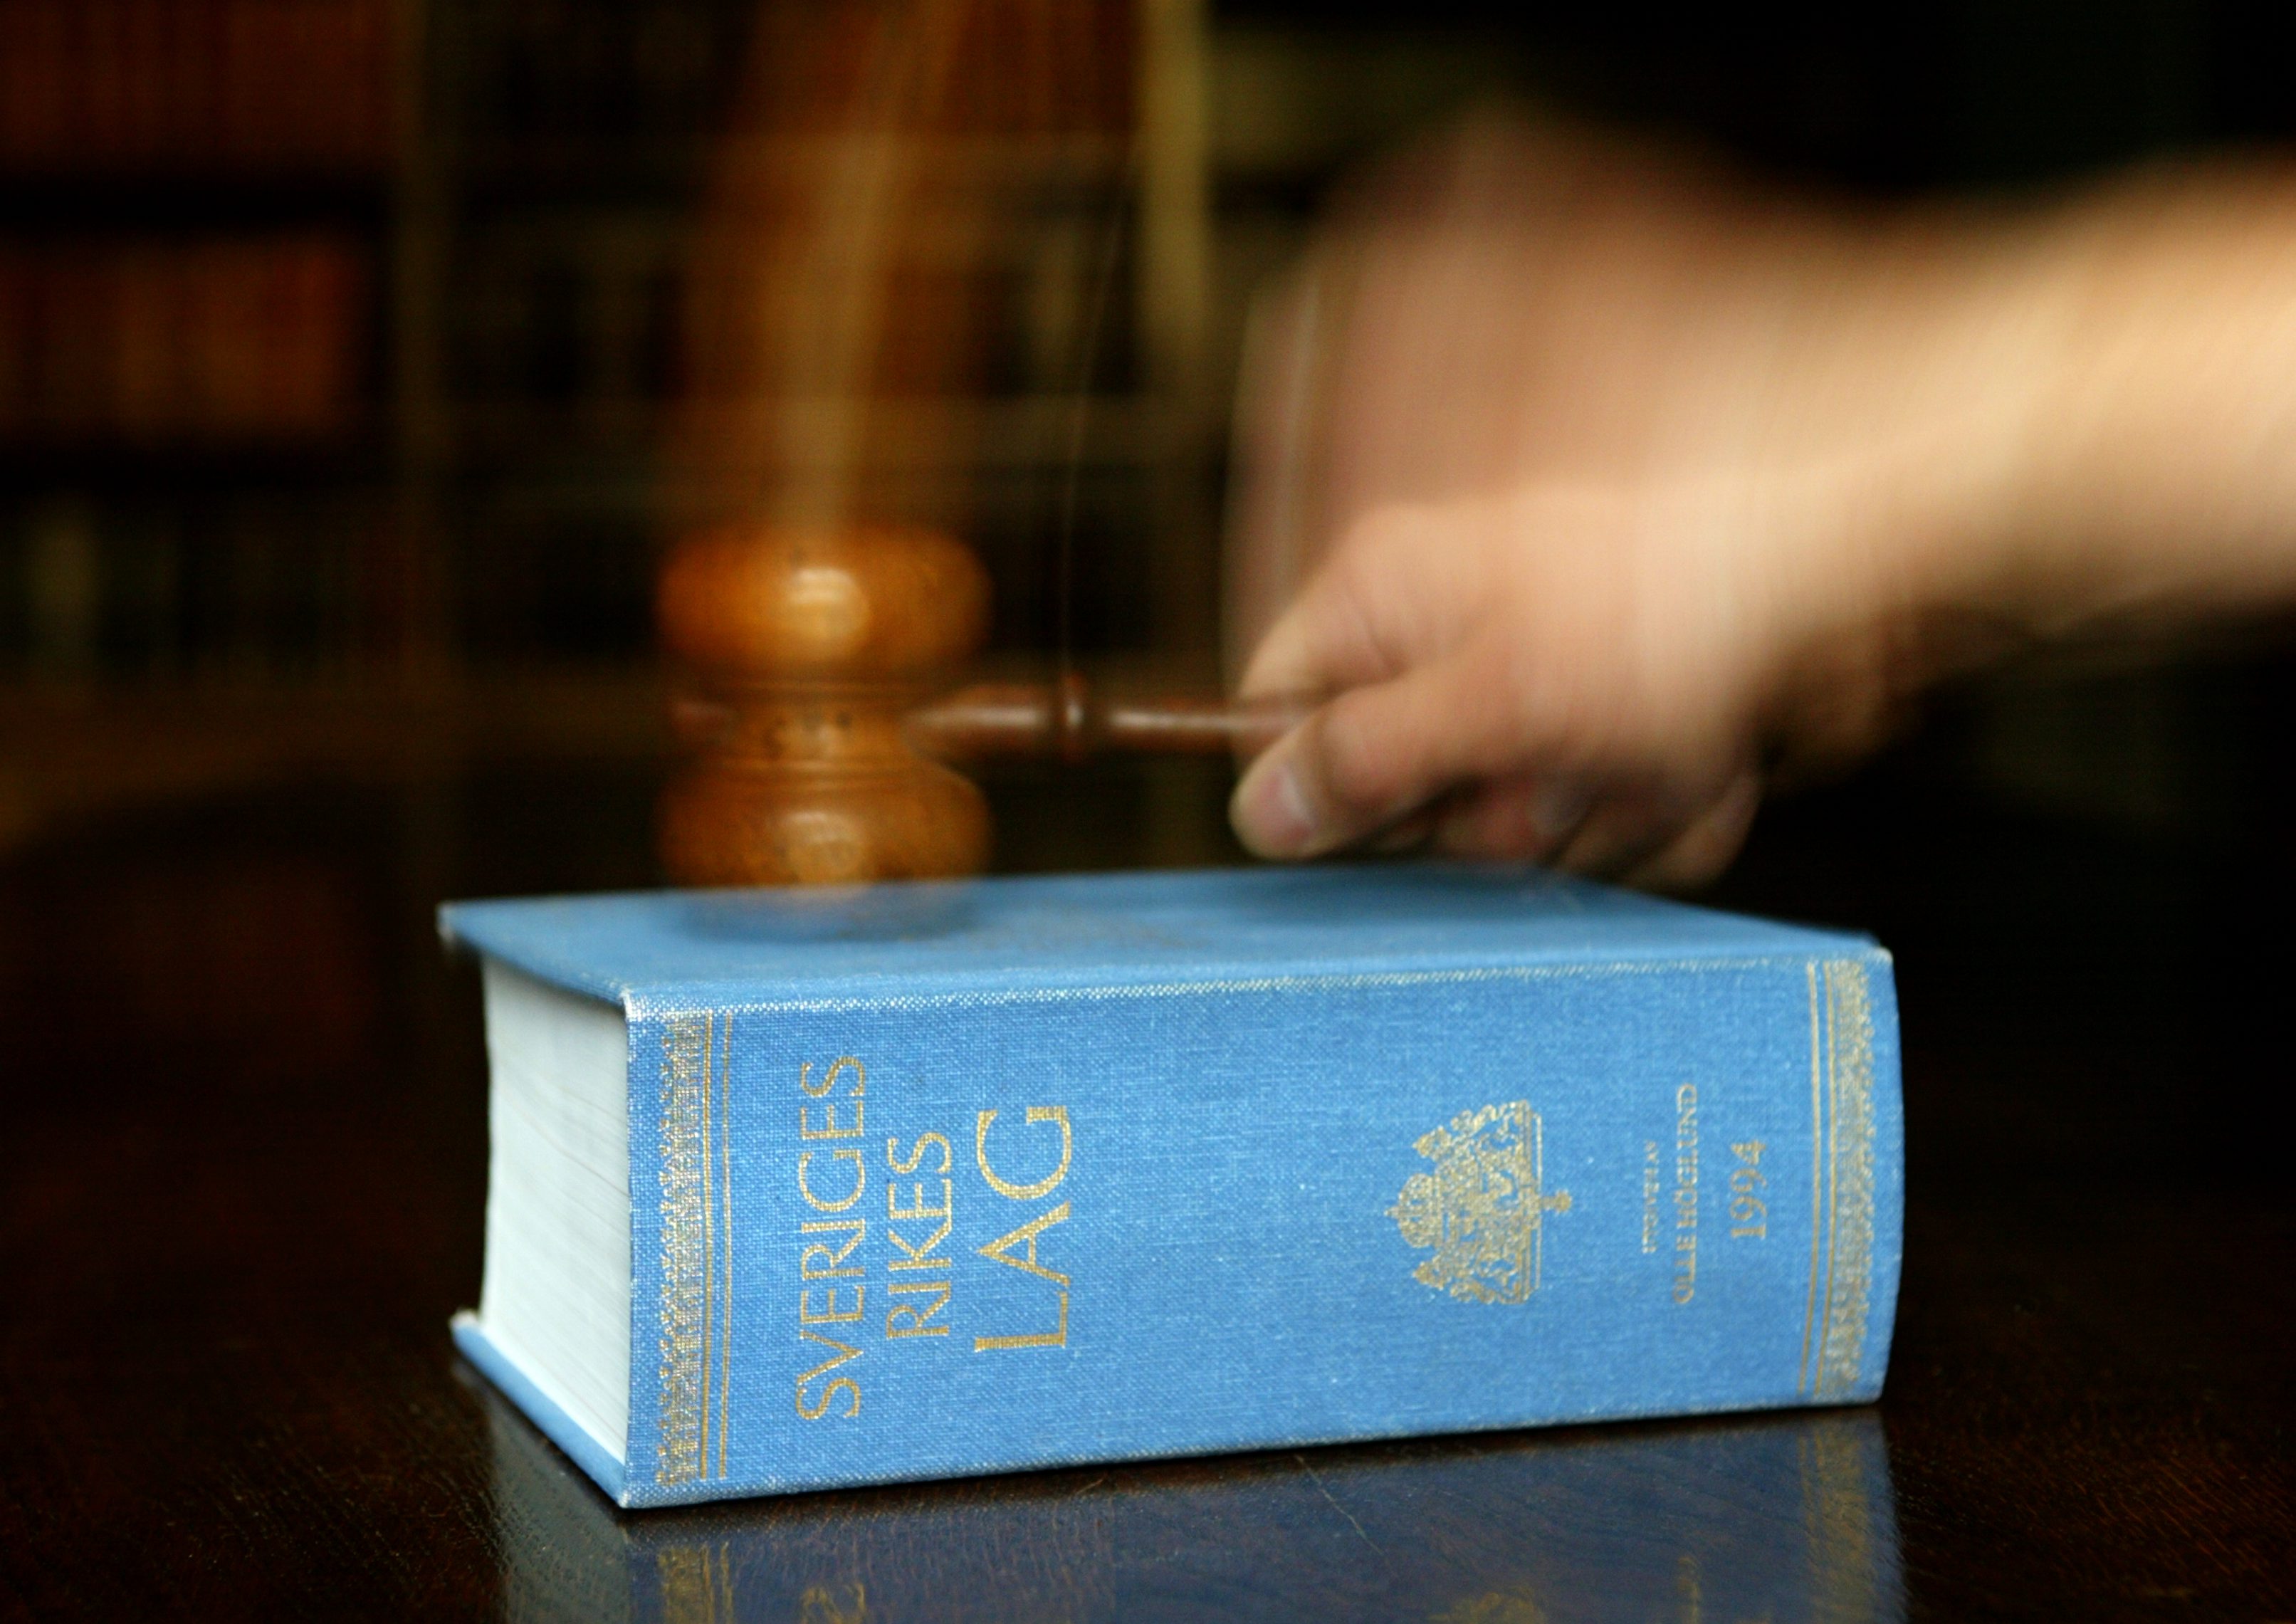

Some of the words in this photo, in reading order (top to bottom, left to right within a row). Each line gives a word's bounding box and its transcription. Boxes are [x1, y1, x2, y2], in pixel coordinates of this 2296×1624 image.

[795, 1054, 866, 1420] SVERIGES
[885, 1131, 953, 1340] RIKES
[975, 1107, 1072, 1352] LAG
[1674, 1083, 1698, 1229] HÖGLUND
[1731, 1140, 1766, 1240] 1994
[1673, 1234, 1697, 1304] OLLE
